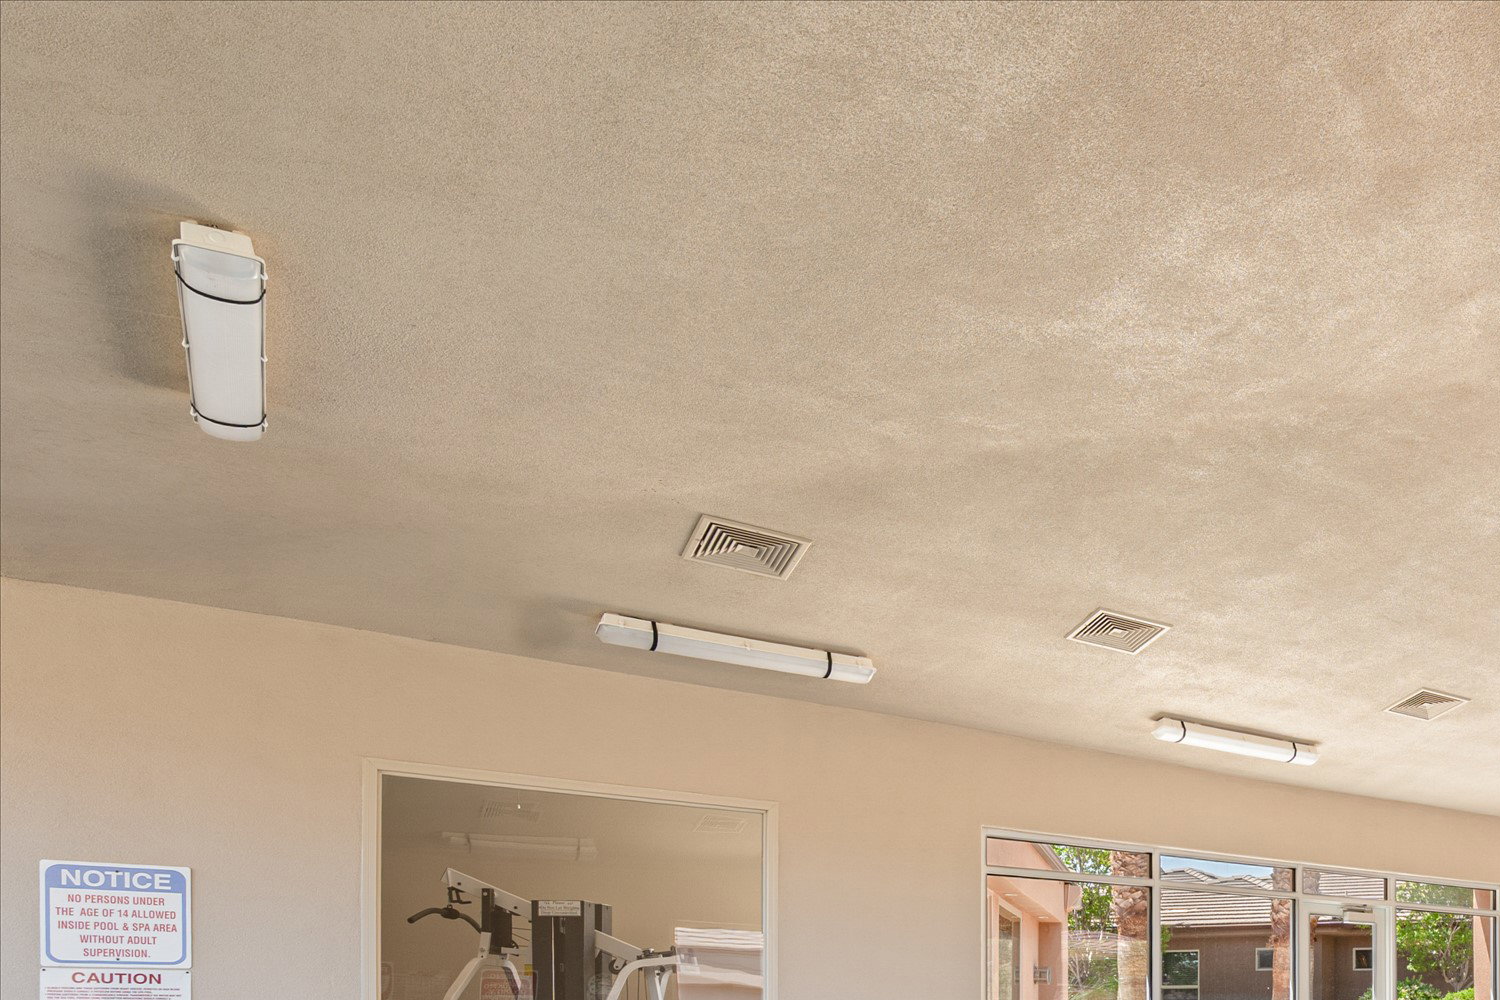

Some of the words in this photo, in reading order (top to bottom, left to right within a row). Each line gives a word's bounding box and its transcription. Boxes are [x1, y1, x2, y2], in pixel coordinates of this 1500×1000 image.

[60, 868, 171, 890] NOTICE
[67, 893, 82, 903] NO
[84, 894, 130, 905] PERSONS
[132, 896, 165, 906] UNDER
[55, 906, 74, 916] THE
[79, 907, 99, 917] AGE
[102, 908, 115, 918] OF
[118, 909, 129, 918] 14
[131, 909, 177, 920] ALLOWED
[57, 920, 90, 930] INSIDE
[93, 921, 119, 931] POOL
[122, 922, 129, 931] &
[132, 922, 151, 932] SPA
[153, 924, 178, 932] AREA
[79, 934, 125, 944] WITHOUT
[127, 936, 157, 945] ADULT
[83, 947, 151, 958] SUPERVISION.
[71, 971, 162, 984] CAUTION
